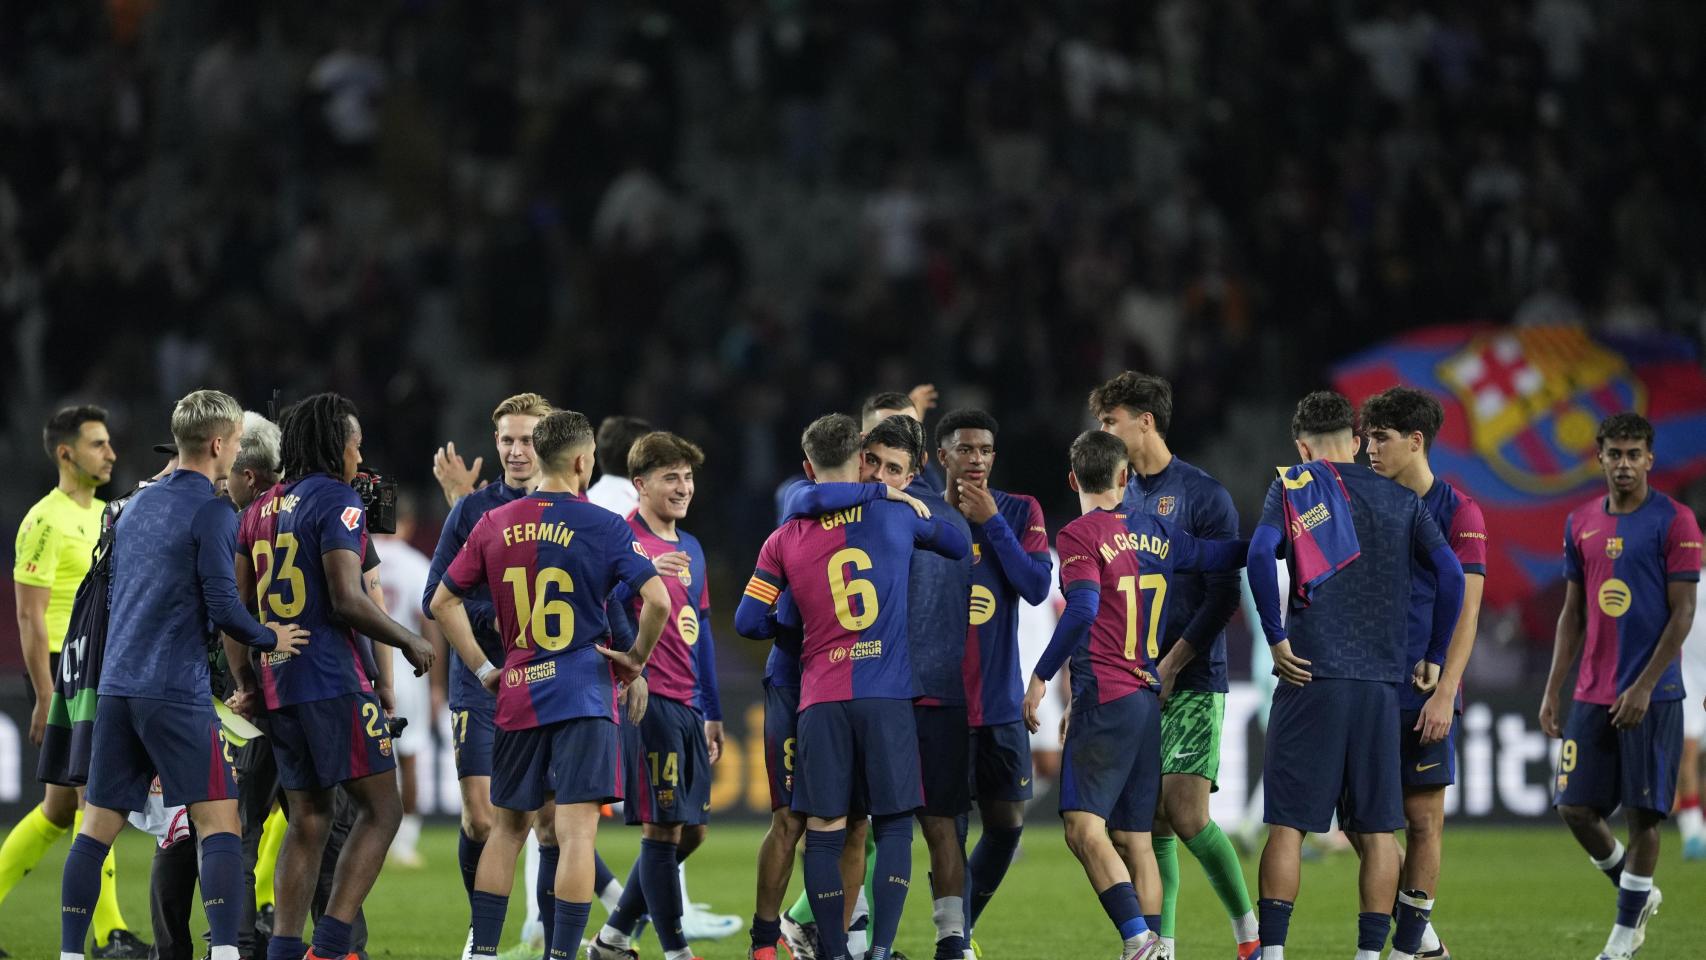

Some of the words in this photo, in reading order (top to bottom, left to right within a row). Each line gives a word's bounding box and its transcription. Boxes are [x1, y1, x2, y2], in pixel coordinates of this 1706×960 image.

[820, 505, 863, 531] GAVI
[1297, 502, 1327, 523] UNHCR
[1303, 509, 1330, 530] ACNUR
[503, 522, 575, 548] FERMÍN
[252, 532, 306, 624] 23
[827, 547, 879, 631] 6
[502, 566, 575, 651] 16
[1116, 573, 1168, 661] 17
[849, 647, 882, 657] ACNUR
[524, 660, 556, 674] UNHCR
[524, 667, 556, 682] ACNUR
[647, 751, 679, 787] 14
